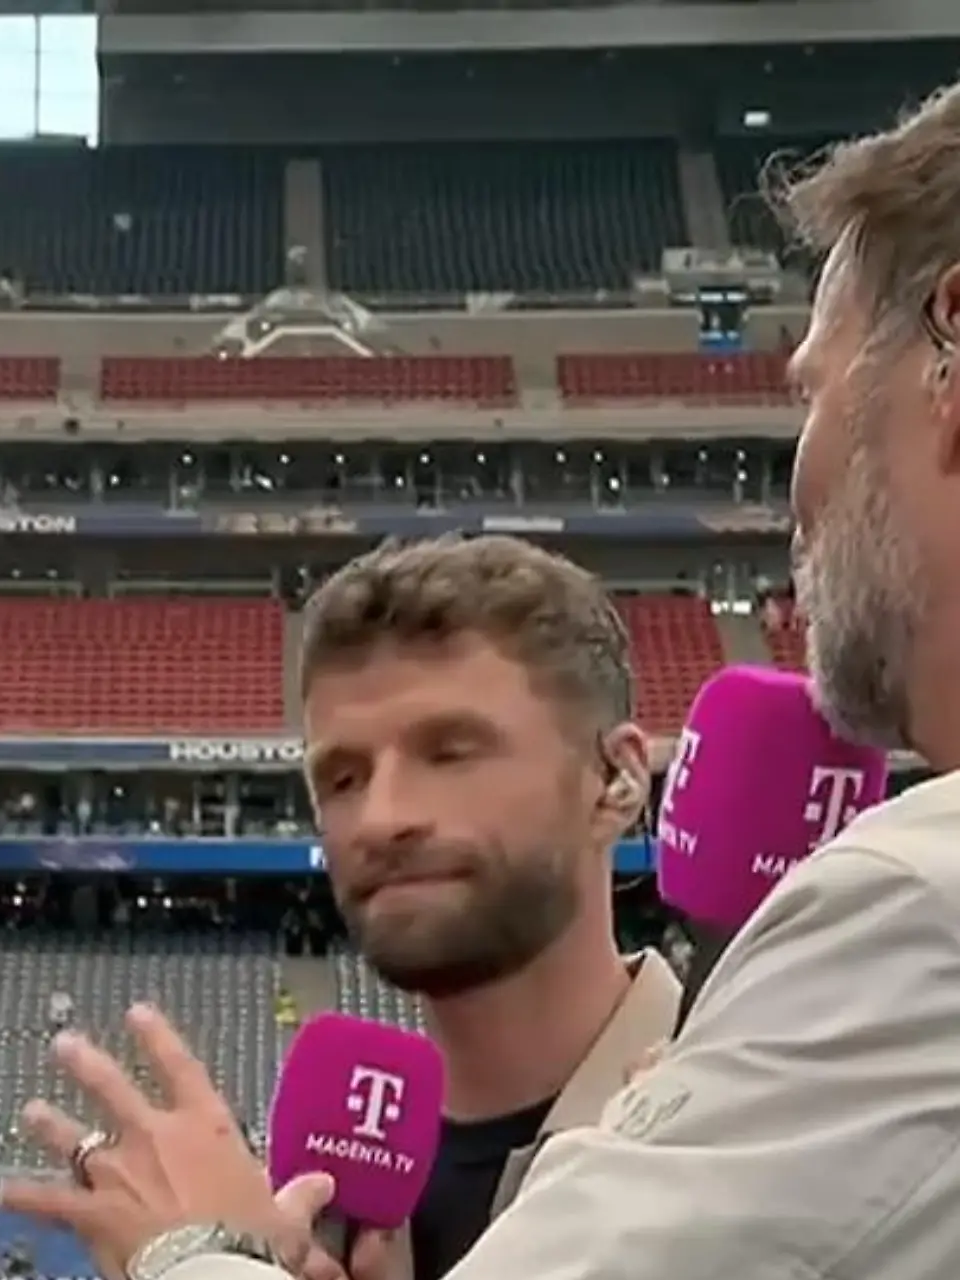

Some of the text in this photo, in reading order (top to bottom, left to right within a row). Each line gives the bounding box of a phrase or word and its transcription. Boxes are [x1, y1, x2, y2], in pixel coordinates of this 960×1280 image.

[752, 853, 797, 876] MA
[346, 1064, 405, 1140] T
[304, 1132, 415, 1174] MAGENTA TV
